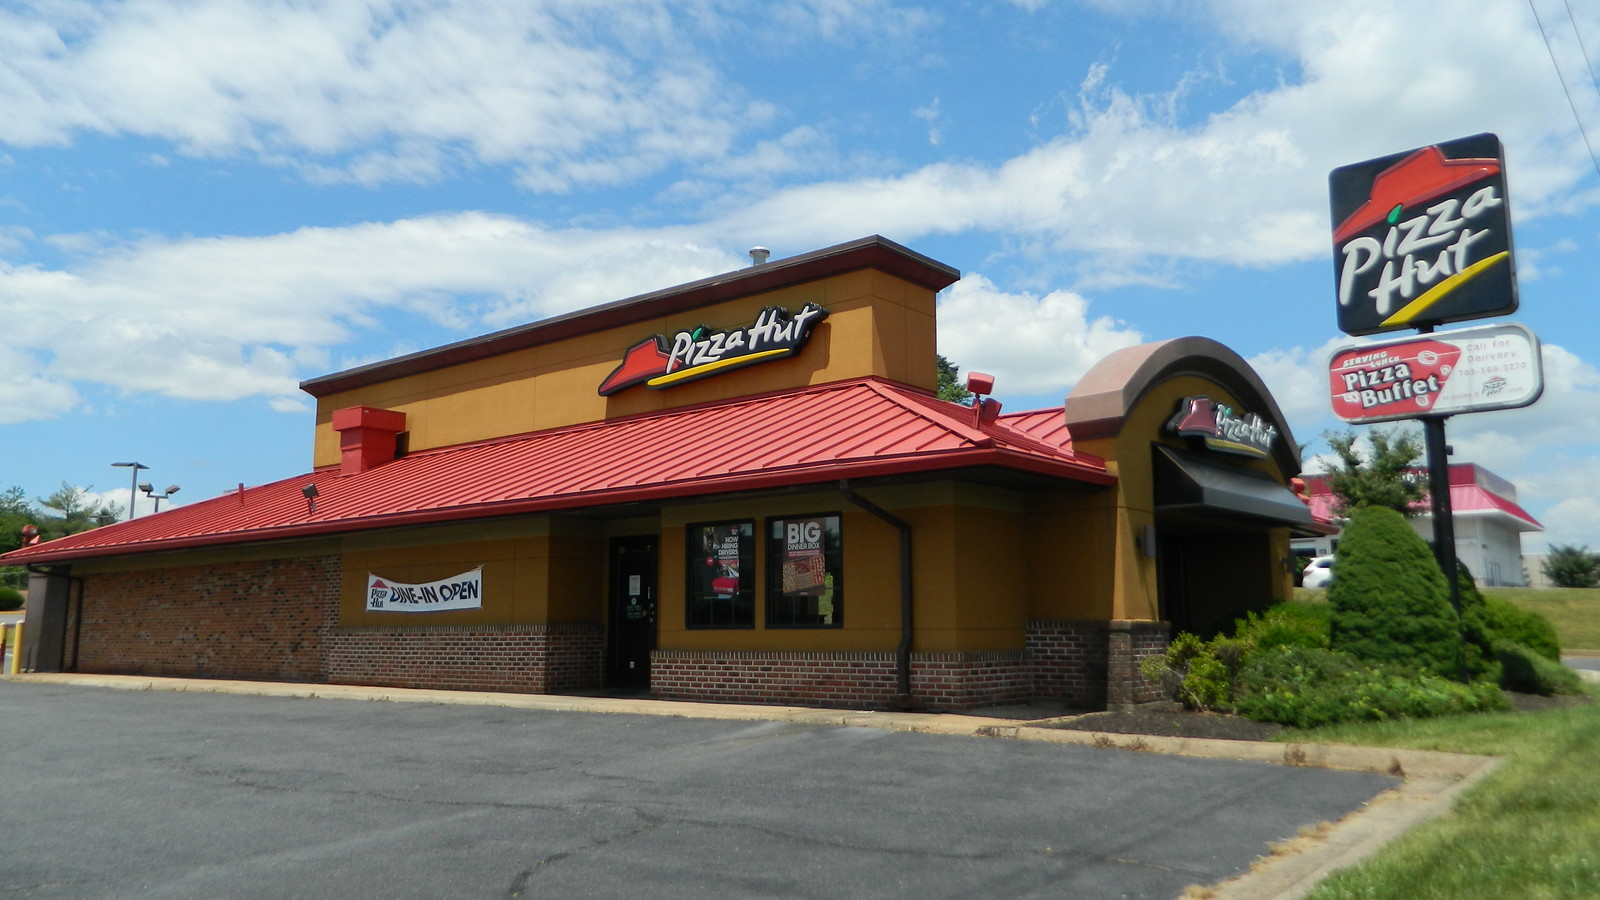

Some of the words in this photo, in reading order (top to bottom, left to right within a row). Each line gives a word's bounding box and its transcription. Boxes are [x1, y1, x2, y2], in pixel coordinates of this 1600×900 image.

[1339, 186, 1502, 306] Pizza
[1368, 228, 1490, 315] Hut
[666, 327, 744, 374] Pizza
[748, 305, 819, 350] Hut
[1466, 343, 1487, 352] Call
[1343, 351, 1388, 368] SERVING
[1370, 356, 1400, 368] LUNCH
[1467, 351, 1517, 363] Delivery
[1344, 363, 1411, 391] Pizza
[1360, 374, 1439, 409] Buffet
[1249, 415, 1277, 447] Hut
[787, 521, 821, 544] BIG
[390, 586, 438, 604] DINE-IN
[440, 580, 478, 602] OPEN
